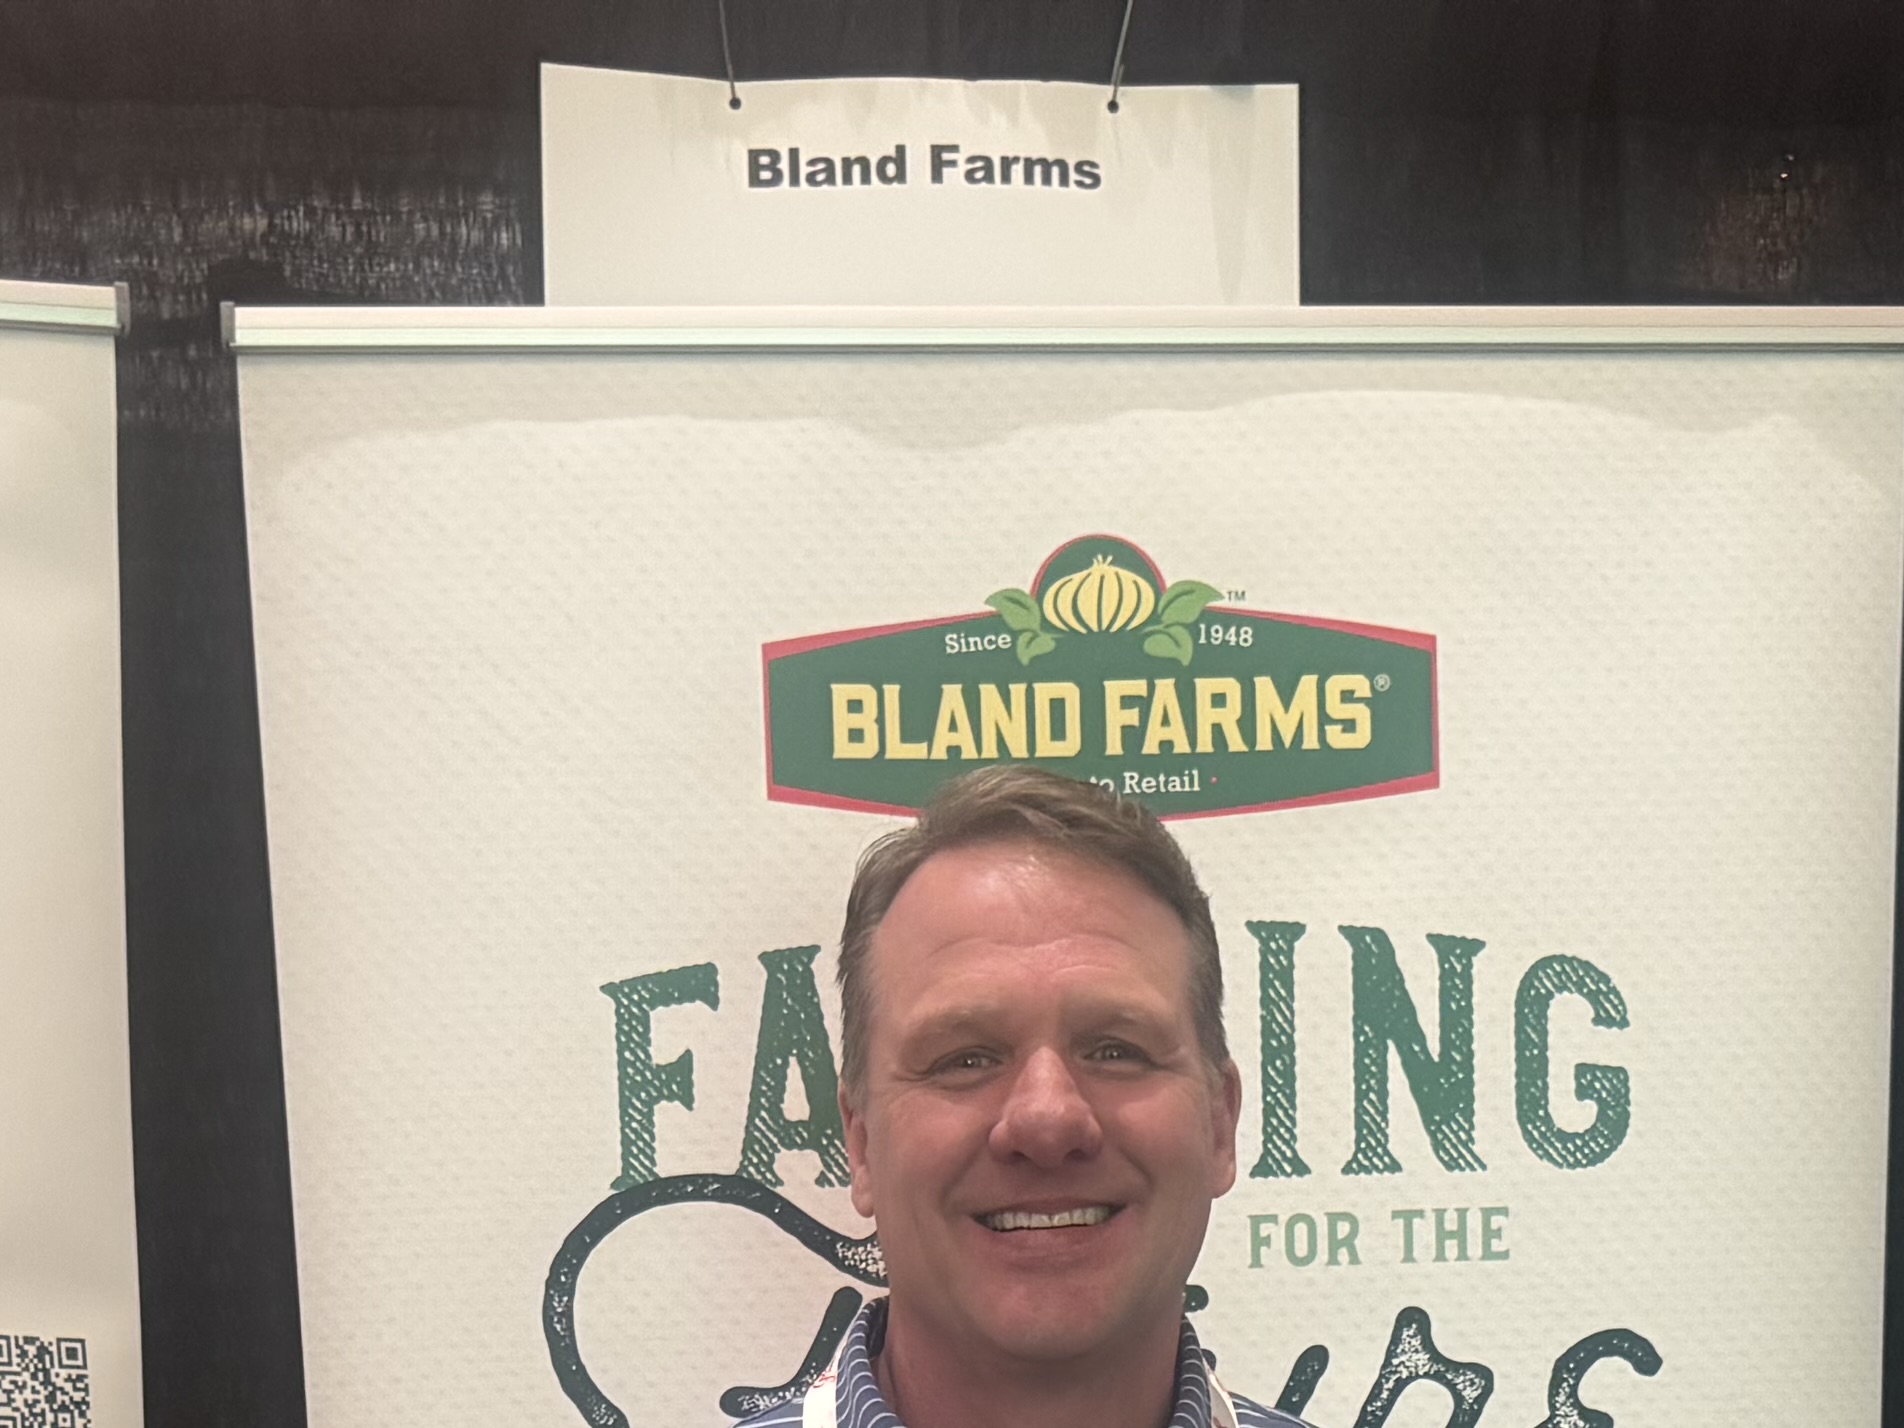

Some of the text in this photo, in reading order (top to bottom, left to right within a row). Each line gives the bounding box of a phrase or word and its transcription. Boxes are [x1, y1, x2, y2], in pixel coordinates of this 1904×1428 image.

[746, 143, 1104, 195] Bland Farms
[945, 624, 1253, 655] Since 1948
[830, 682, 1081, 761] BLAND
[1123, 769, 1200, 794] Retail
[601, 919, 1633, 1189] FAING
[1248, 1205, 1511, 1269] FOR THE
